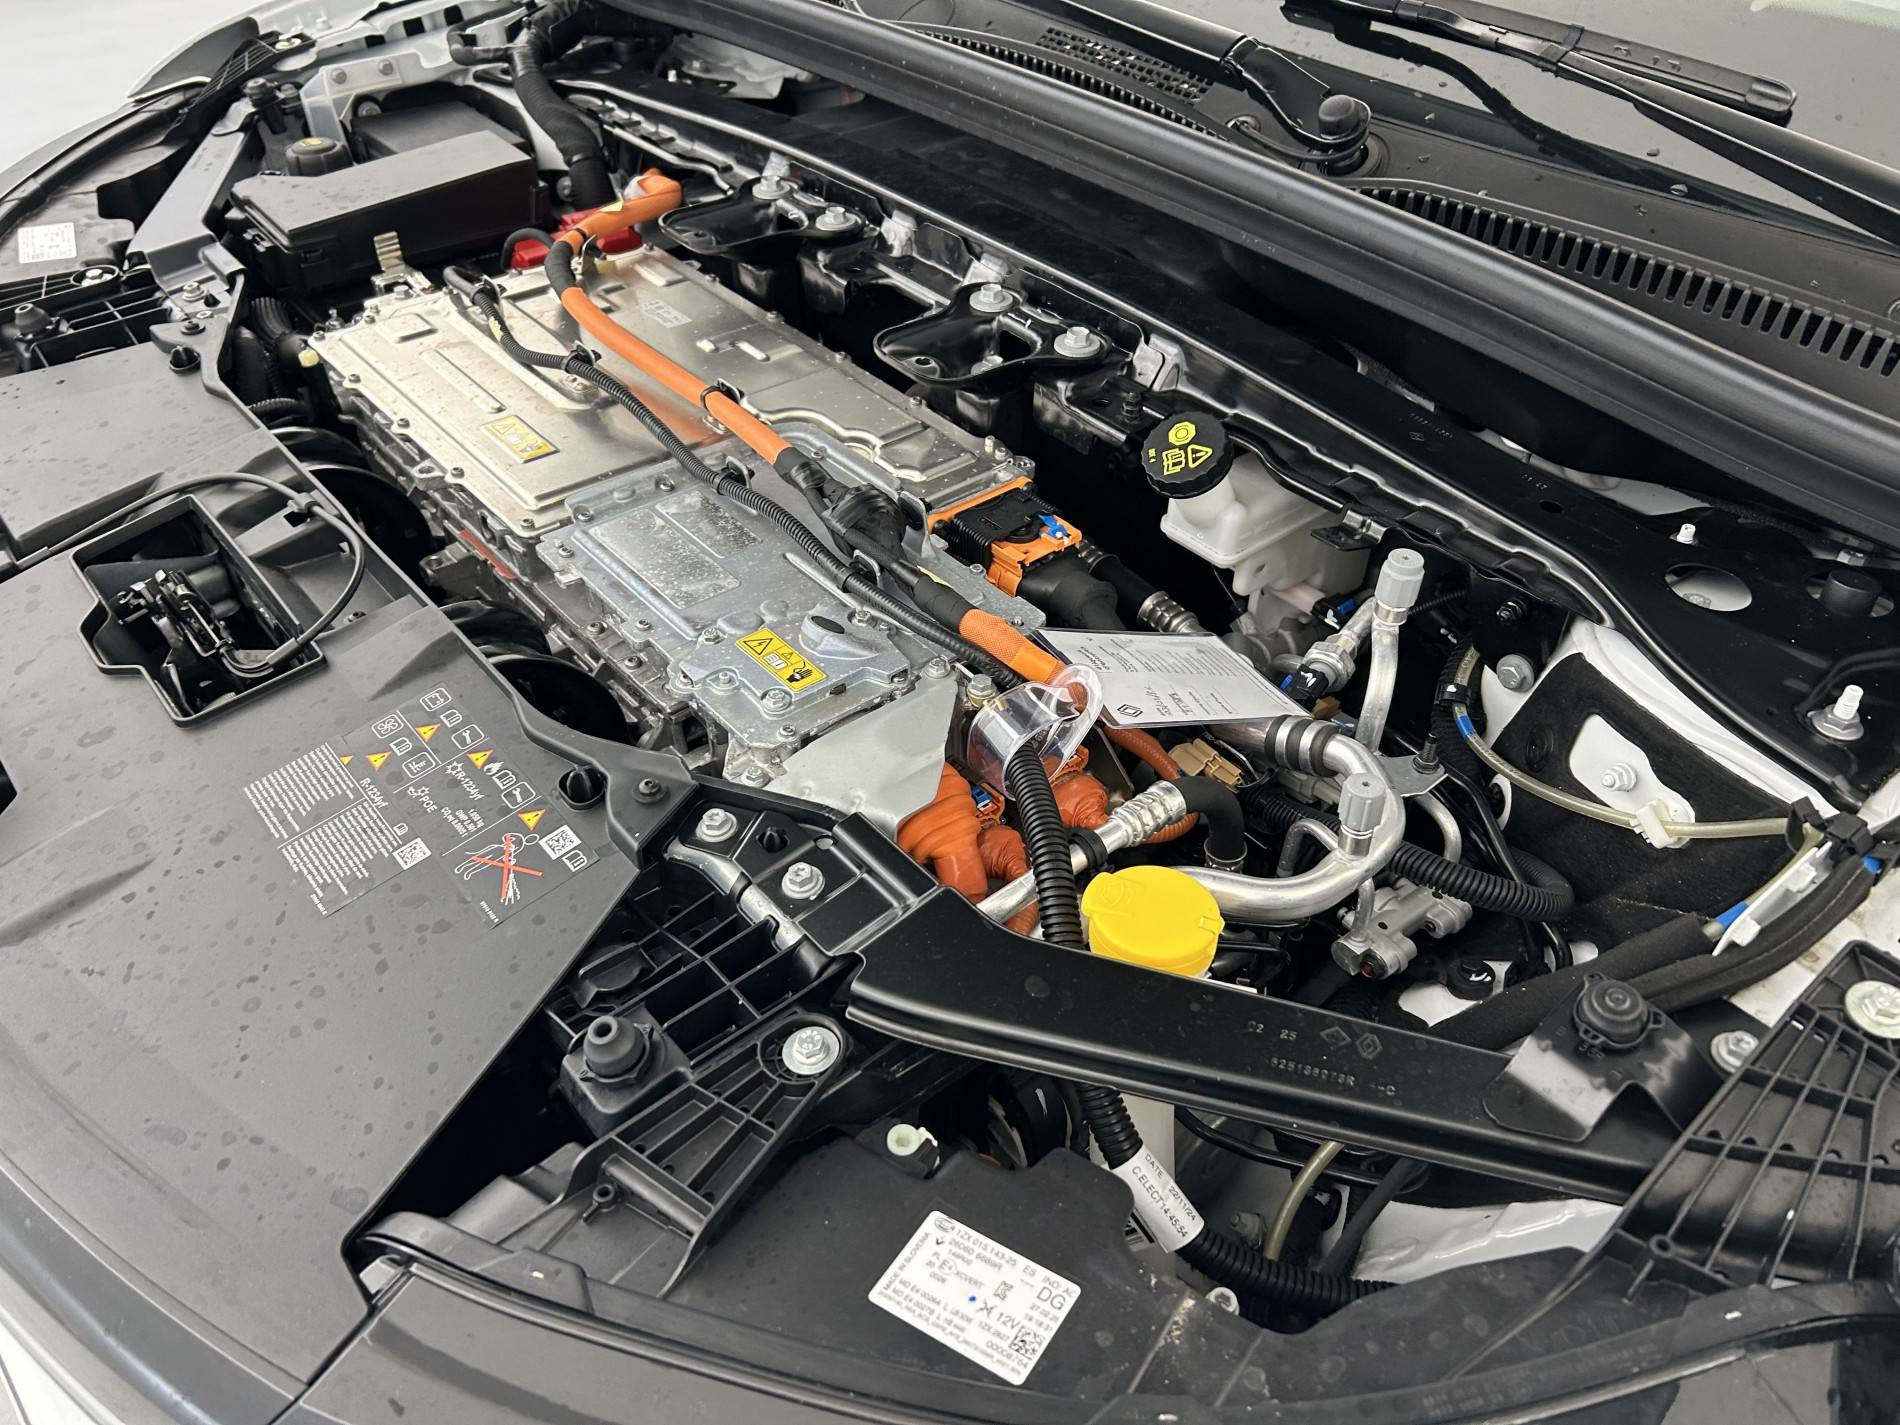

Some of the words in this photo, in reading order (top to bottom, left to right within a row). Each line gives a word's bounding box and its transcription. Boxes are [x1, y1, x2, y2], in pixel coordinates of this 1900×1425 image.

[360, 777, 387, 809] R-1234yf
[455, 770, 484, 800] R-1234yf
[418, 795, 436, 813] POE
[1144, 1153, 1163, 1178] DATE
[1168, 1185, 1196, 1221] 22/11/24
[1036, 1286, 1066, 1311] DG
[996, 1311, 1021, 1330] 12V
